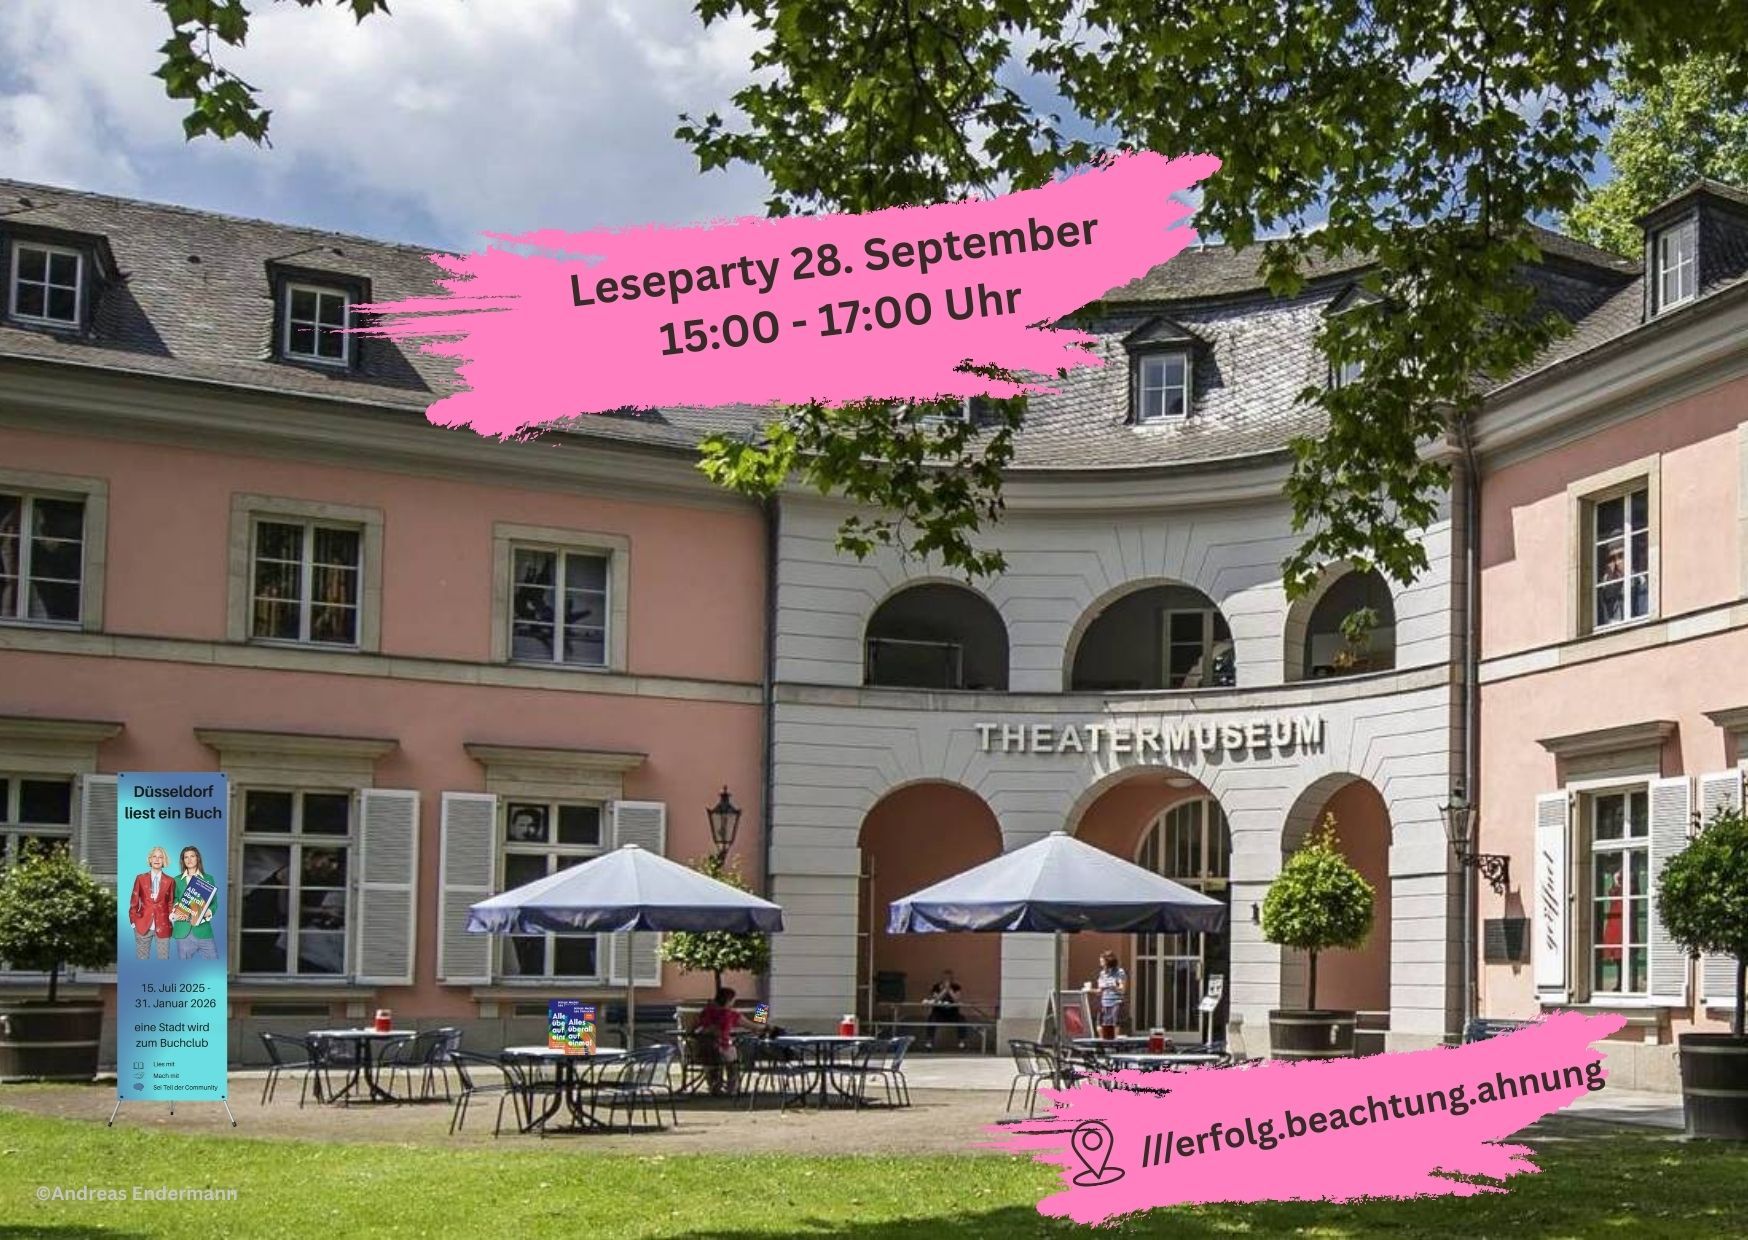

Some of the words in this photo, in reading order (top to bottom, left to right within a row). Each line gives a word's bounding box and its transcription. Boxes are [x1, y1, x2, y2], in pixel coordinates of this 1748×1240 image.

[975, 714, 1323, 753] THEATERMUSEUM
[133, 785, 214, 798] Düsseldorf
[124, 807, 156, 820] liest
[158, 807, 181, 820] ein
[185, 807, 222, 820] Buch
[141, 983, 156, 993] 15.
[158, 983, 177, 993] Juli
[180, 983, 205, 993] 2025
[135, 999, 151, 1008] 31.
[153, 999, 188, 1008] Januar
[191, 999, 216, 1008] 2026
[552, 1012, 565, 1020] Alle
[134, 1023, 157, 1032] eine
[158, 1022, 185, 1032] Stadt
[187, 1022, 210, 1032] wird
[136, 1039, 157, 1048] zum
[160, 1038, 209, 1048] Buchclub
[185, 1084, 218, 1092] Community
